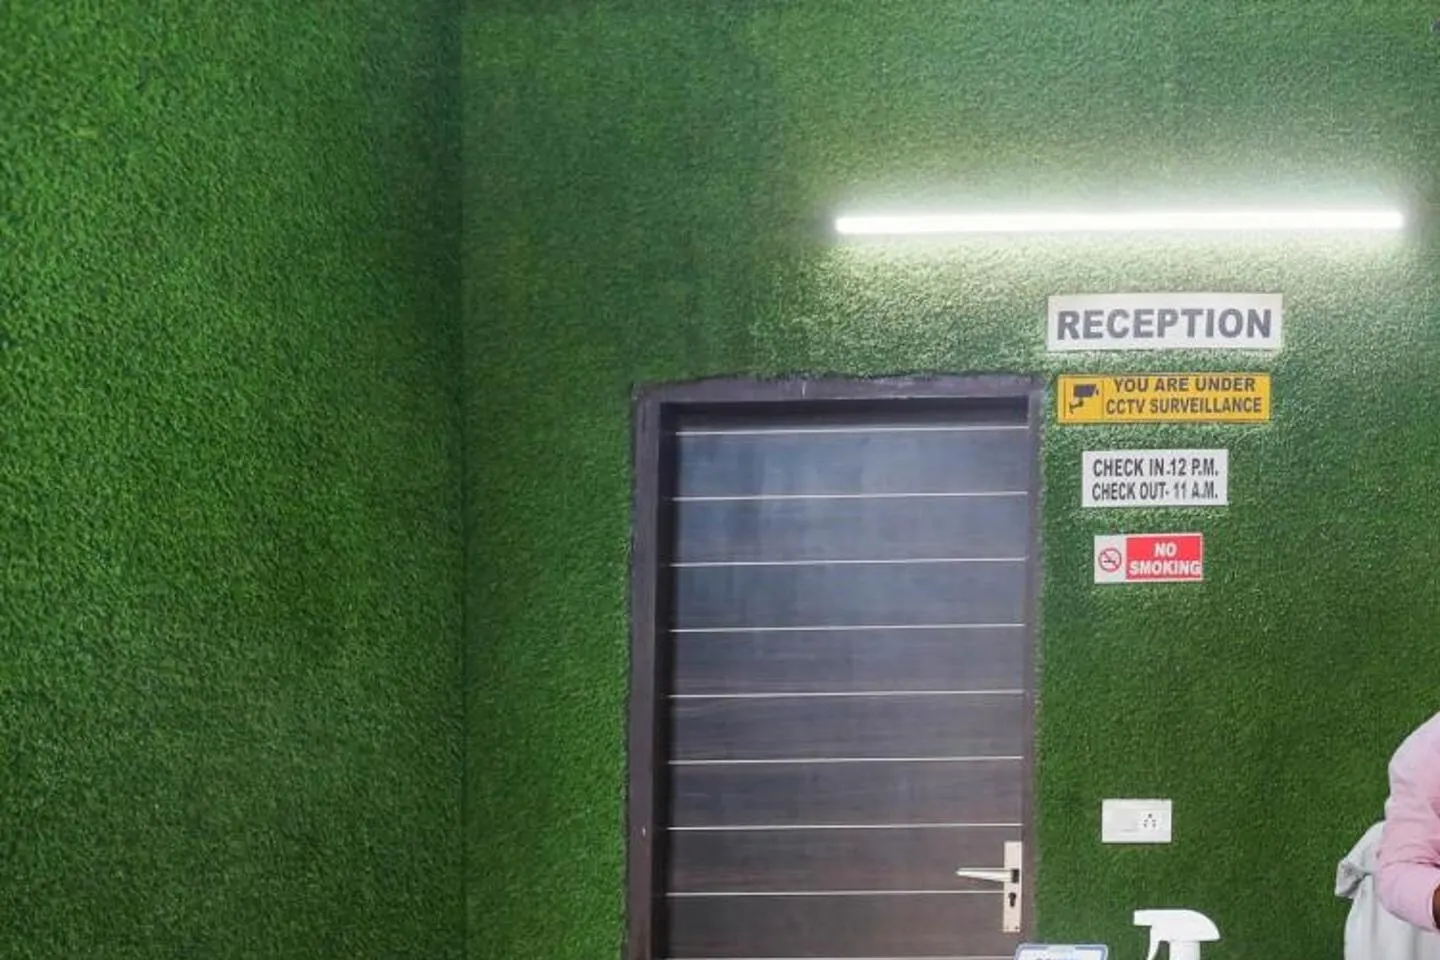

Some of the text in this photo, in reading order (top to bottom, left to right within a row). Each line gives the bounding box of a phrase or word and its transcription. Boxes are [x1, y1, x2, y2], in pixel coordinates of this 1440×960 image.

[1057, 308, 1272, 340] RECEPTION
[1113, 377, 1256, 393] YOU ARE UNDER
[1106, 397, 1262, 414] CCTV SURVEILLANCE
[1093, 457, 1144, 477] CHECK
[1191, 457, 1218, 477] P.M.
[1091, 481, 1136, 501] CHECK
[1173, 481, 1187, 500] 11
[1154, 542, 1178, 558] NO
[1128, 559, 1201, 576] SMOKING
